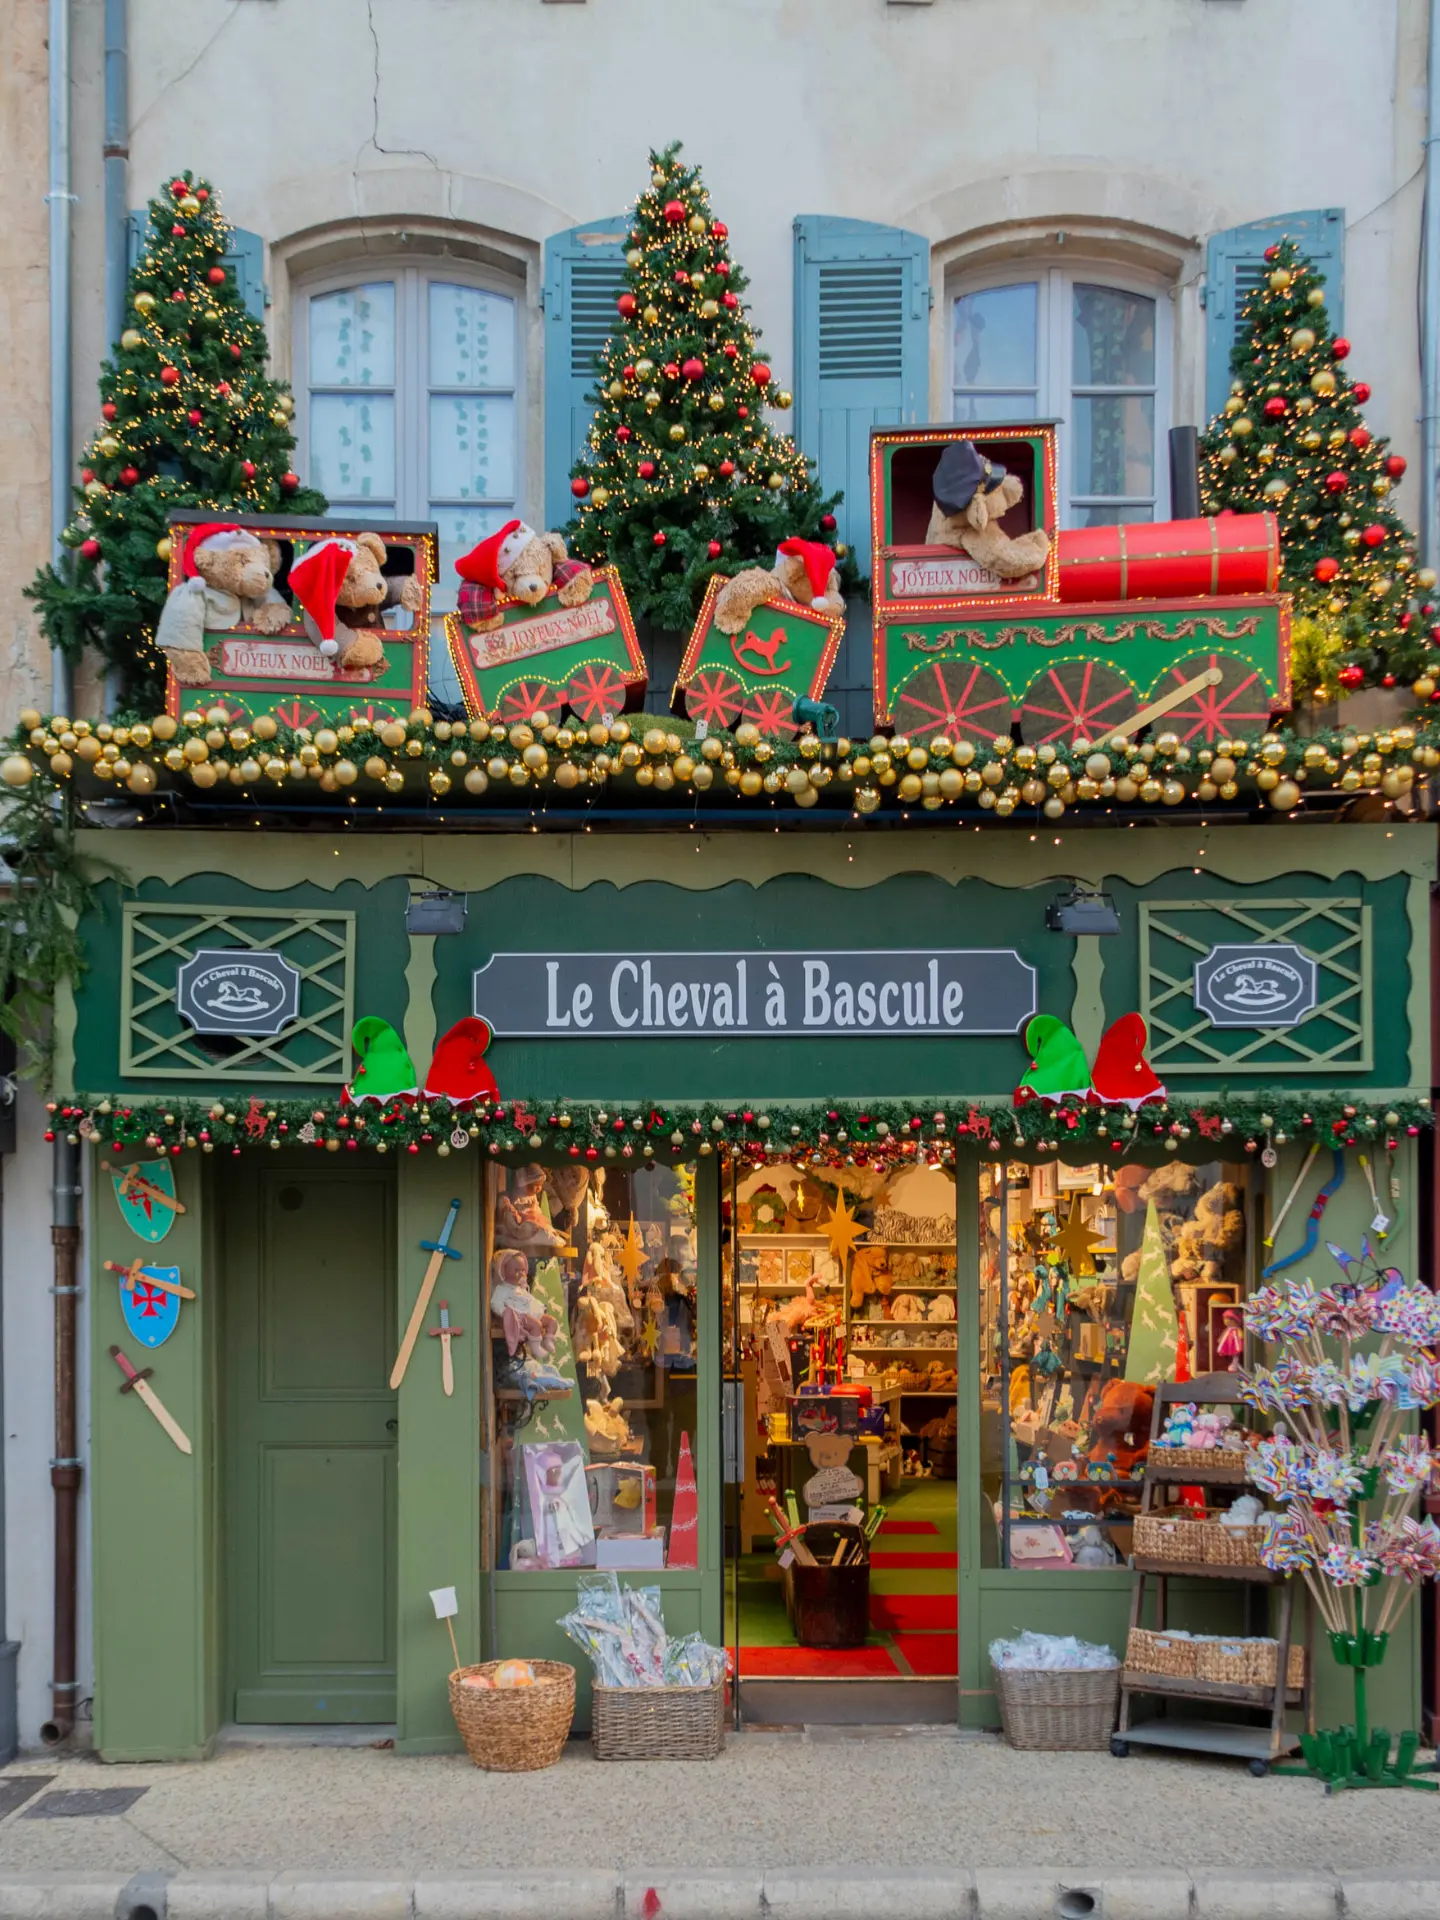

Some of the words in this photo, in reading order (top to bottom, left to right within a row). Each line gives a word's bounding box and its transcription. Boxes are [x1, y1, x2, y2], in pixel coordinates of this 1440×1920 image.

[901, 569, 955, 592] JOYEUX
[511, 619, 566, 648] JOYEUX
[233, 649, 288, 672] JOYEUX
[291, 652, 329, 672] NOËL
[197, 979, 210, 989] Le
[209, 967, 240, 981] Cheval
[240, 968, 247, 976] à
[248, 968, 280, 991] Bascule
[1213, 972, 1226, 983] Le
[1225, 960, 1256, 975] Cheval
[1256, 961, 1264, 969] à
[1264, 961, 1298, 982] Bascule
[545, 961, 594, 1027] Le
[609, 959, 748, 1028] Cheval
[765, 960, 787, 1027] à
[802, 958, 964, 1027] Bascule
